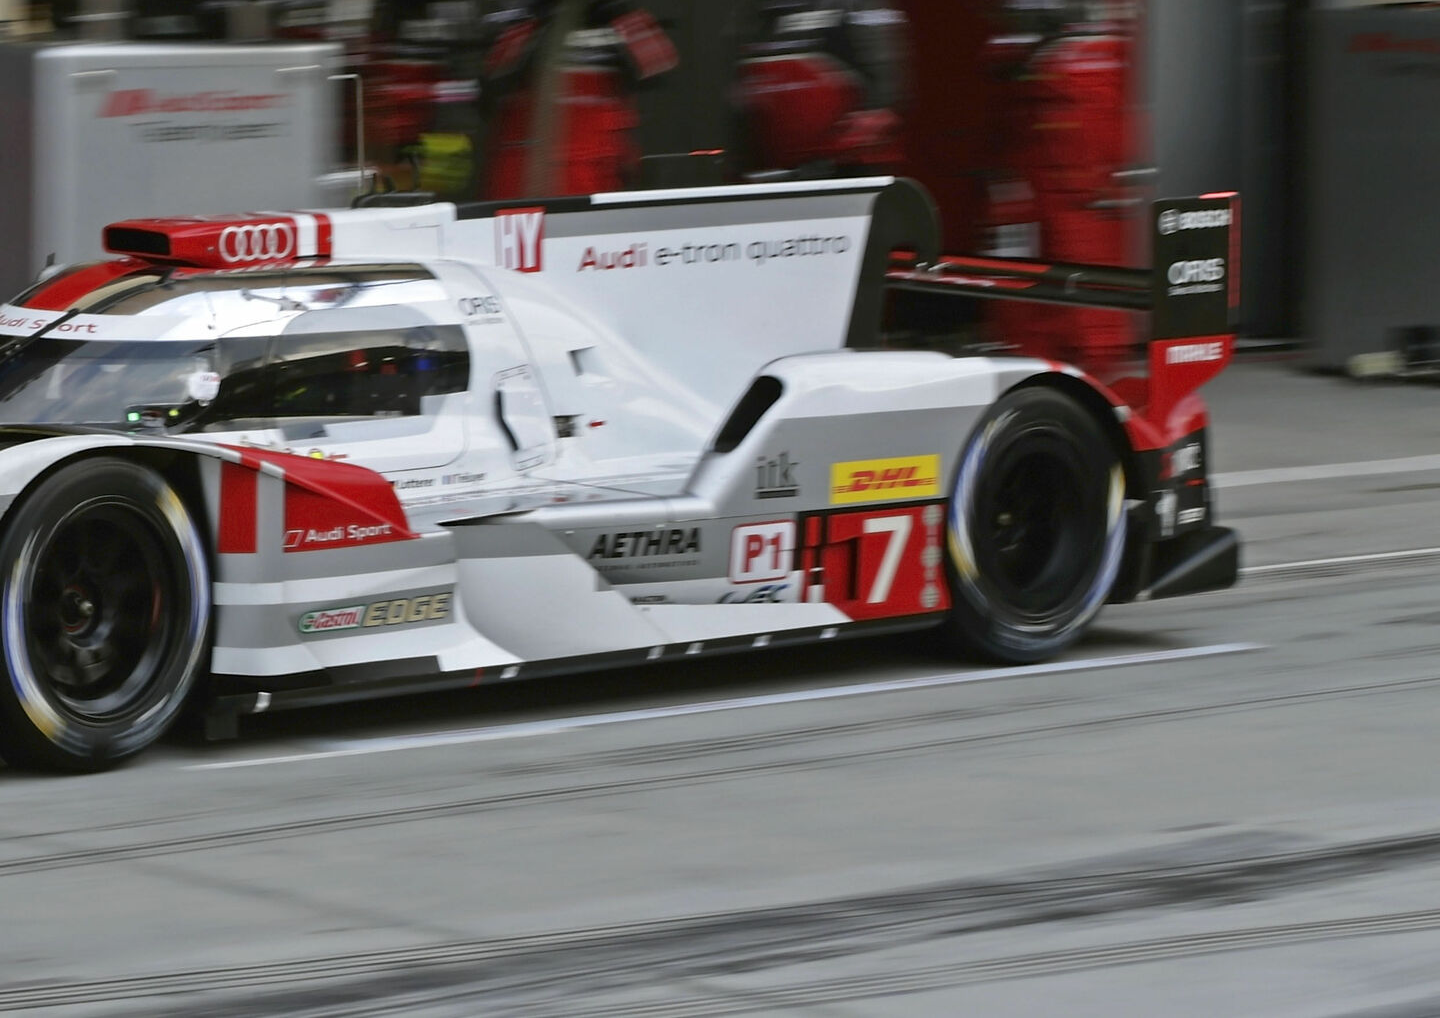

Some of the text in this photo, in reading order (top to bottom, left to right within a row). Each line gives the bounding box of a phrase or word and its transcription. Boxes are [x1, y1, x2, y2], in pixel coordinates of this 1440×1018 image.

[495, 211, 545, 271] HY
[578, 234, 851, 272] Audi e-tron quattro
[28, 319, 98, 334] Sort
[848, 466, 921, 492] DHL
[304, 523, 393, 543] Audi Sport
[588, 526, 702, 560] AETHRA
[742, 531, 782, 573] P1
[863, 515, 914, 605] 7
[363, 592, 453, 628] EDGE
